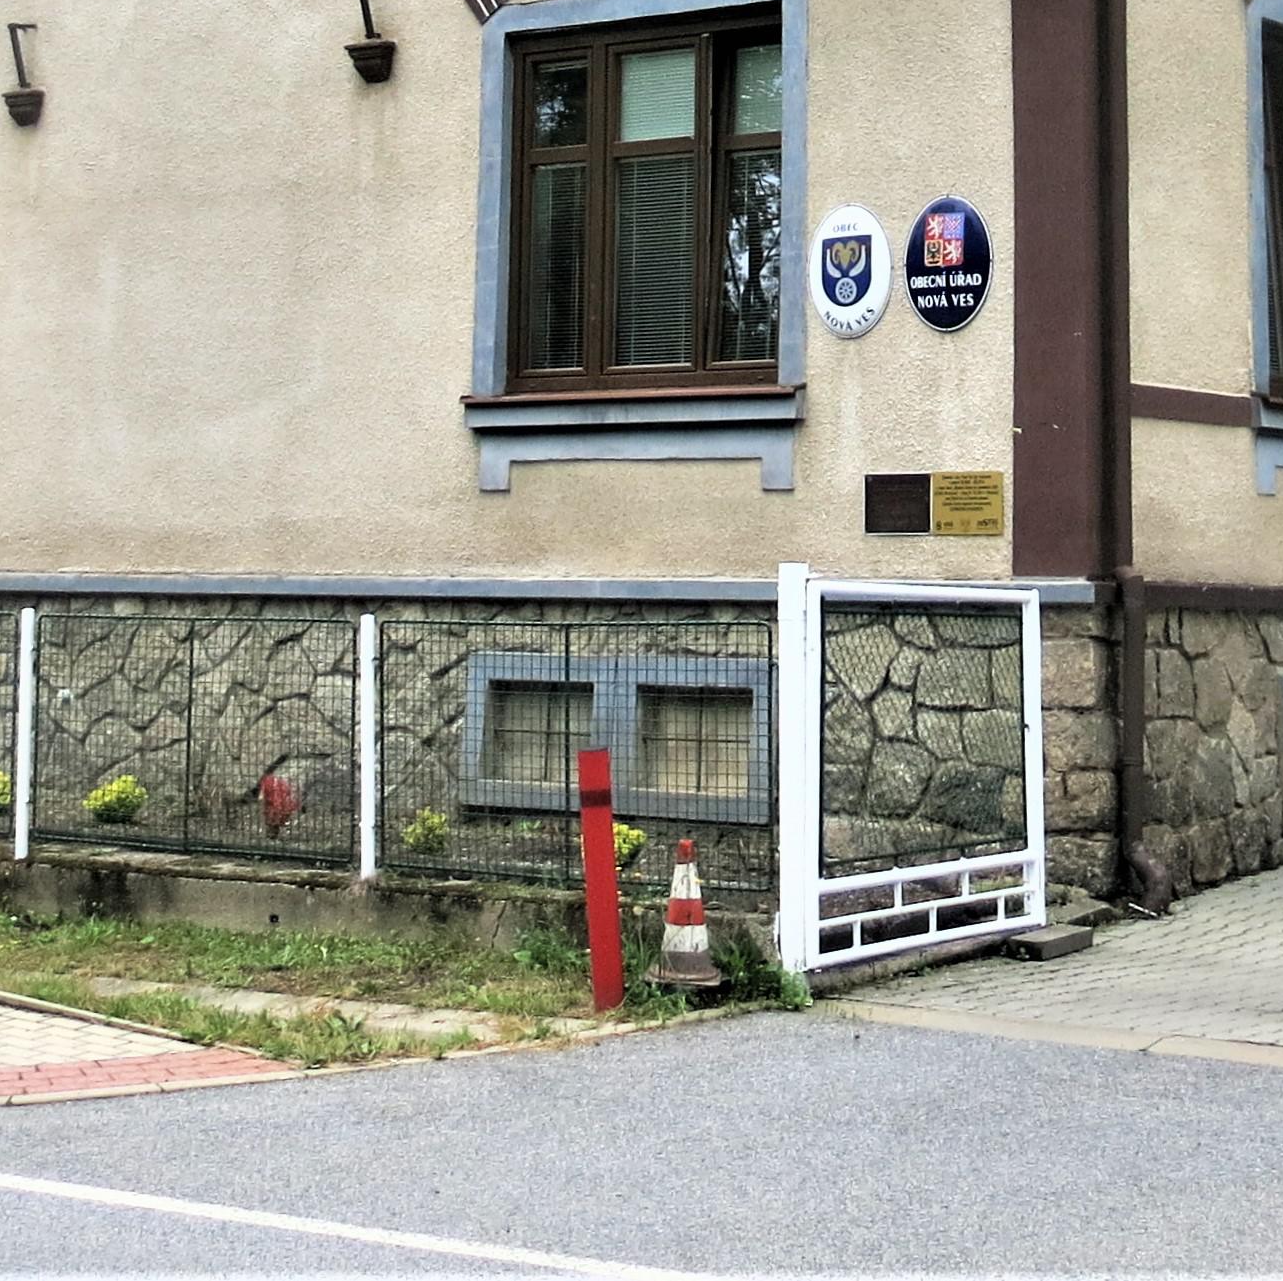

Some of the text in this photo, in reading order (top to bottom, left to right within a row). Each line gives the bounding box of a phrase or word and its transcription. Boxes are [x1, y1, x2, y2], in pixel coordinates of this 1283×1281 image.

[832, 222, 859, 233] OBEC
[910, 270, 982, 289] OBECNÍ ÚŘAD
[917, 291, 974, 309] NOVÁ VES
[855, 307, 876, 326] VES
